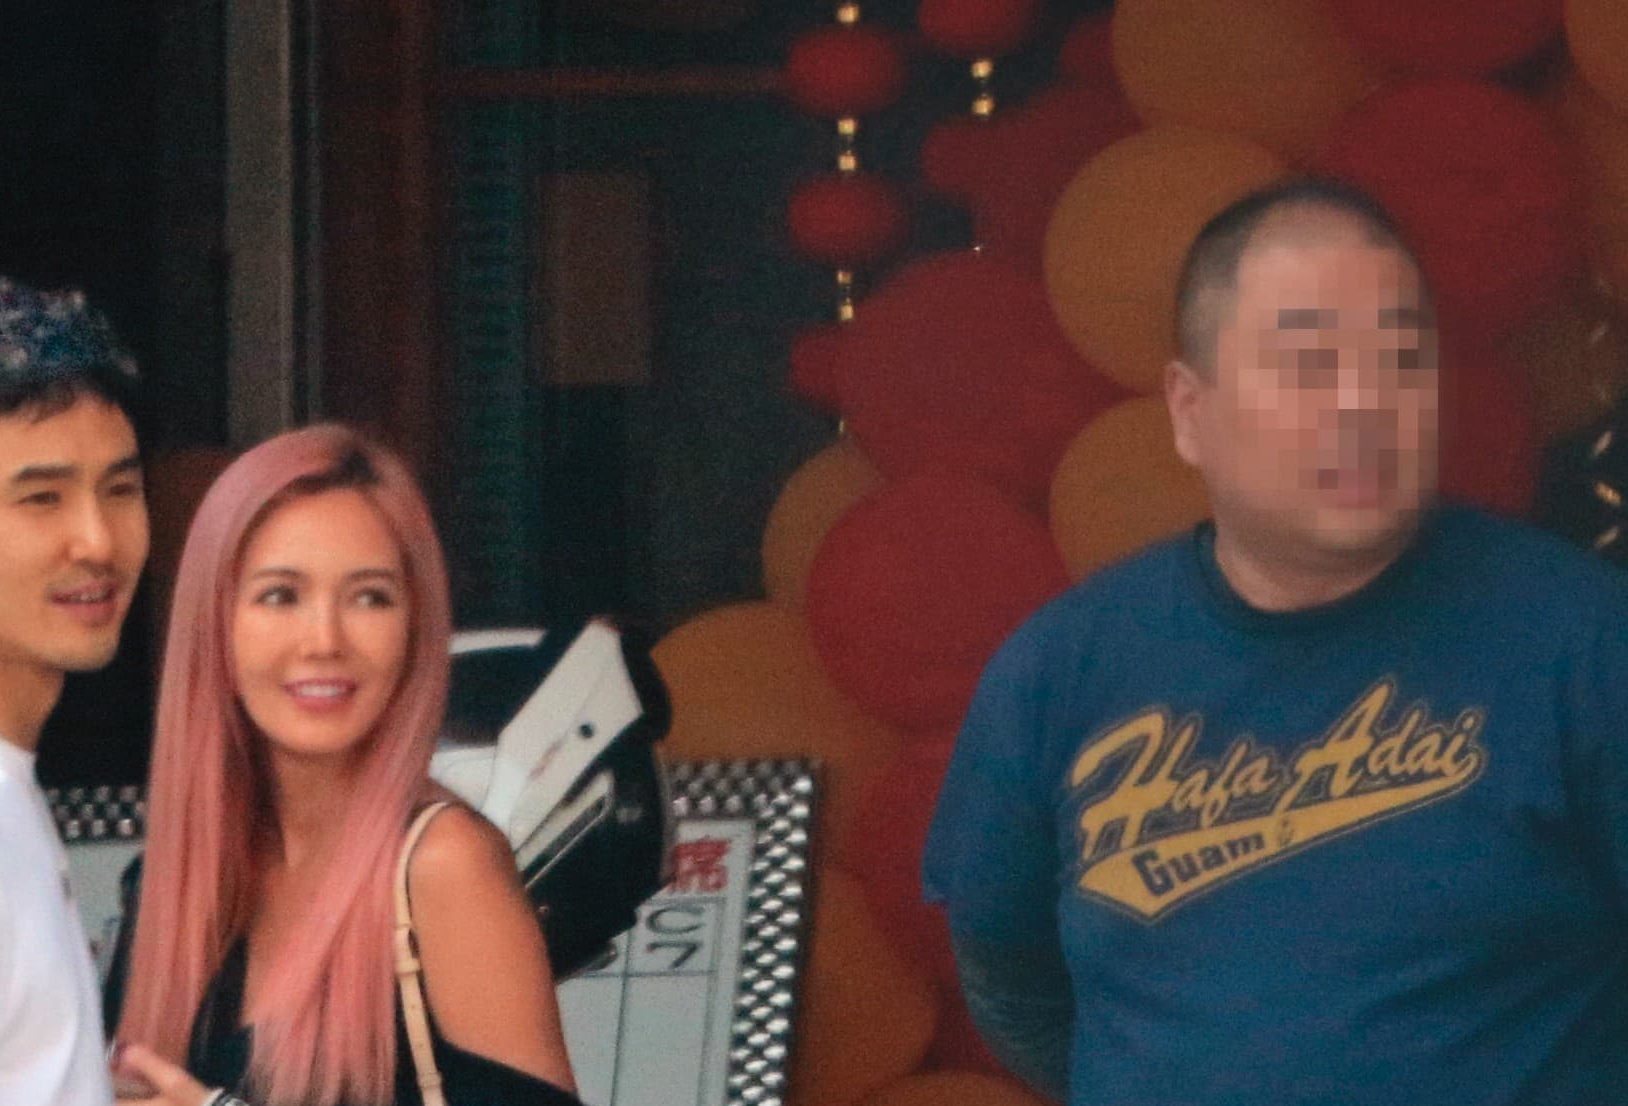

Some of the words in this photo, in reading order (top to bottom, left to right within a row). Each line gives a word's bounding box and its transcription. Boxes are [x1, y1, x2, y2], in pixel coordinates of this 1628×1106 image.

[1070, 708, 1278, 862] Hafa
[1275, 680, 1482, 818] Adai
[1130, 827, 1266, 897] Guam
